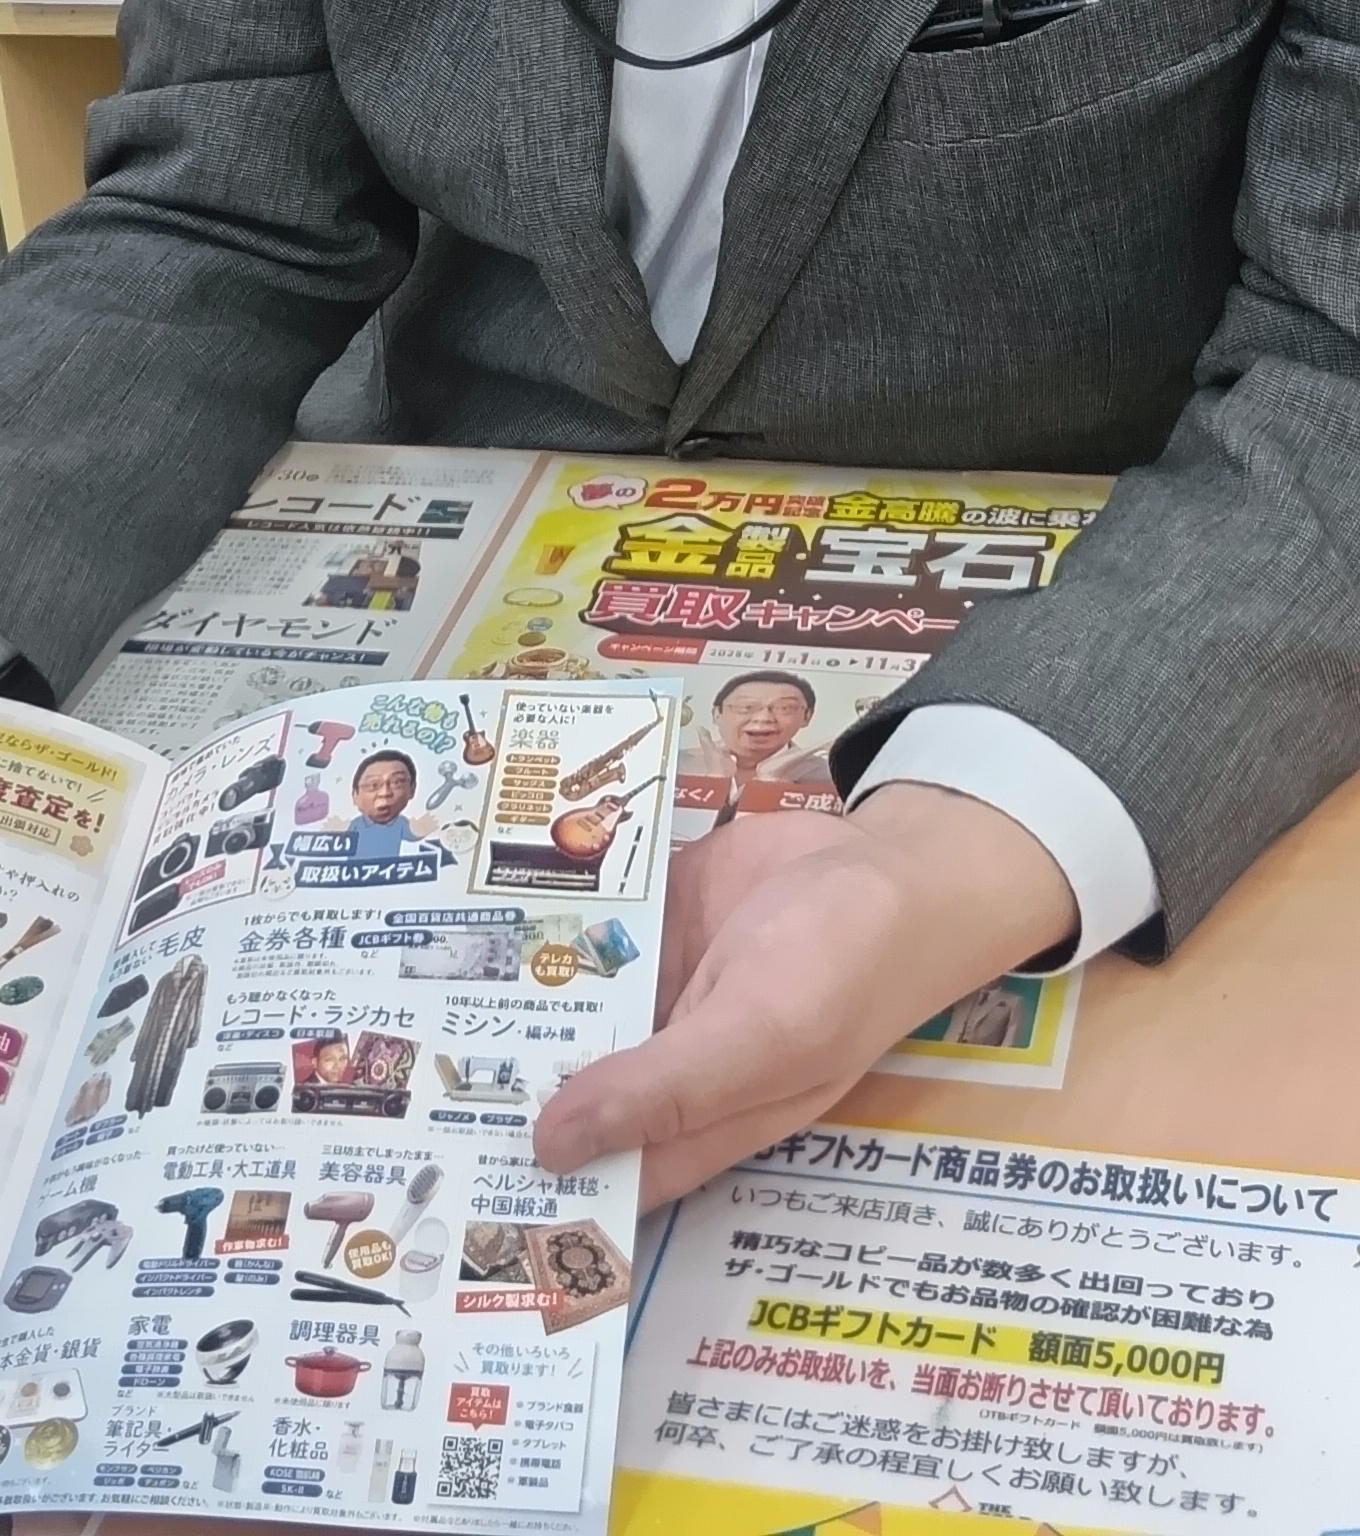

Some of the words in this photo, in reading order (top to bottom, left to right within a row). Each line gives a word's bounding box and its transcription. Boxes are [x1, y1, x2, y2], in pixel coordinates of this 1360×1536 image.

[140, 607, 399, 646] ダイヤモンド
[299, 860, 434, 885] 取扱いアイテム
[238, 926, 348, 954] 金券各種
[221, 1005, 416, 1028] レコード・ラジカセ
[319, 1159, 408, 1186] 美容器具
[128, 1314, 172, 1338] 家電
[288, 1319, 383, 1346] 調理器具
[748, 1300, 999, 1357] JCBギフトカード
